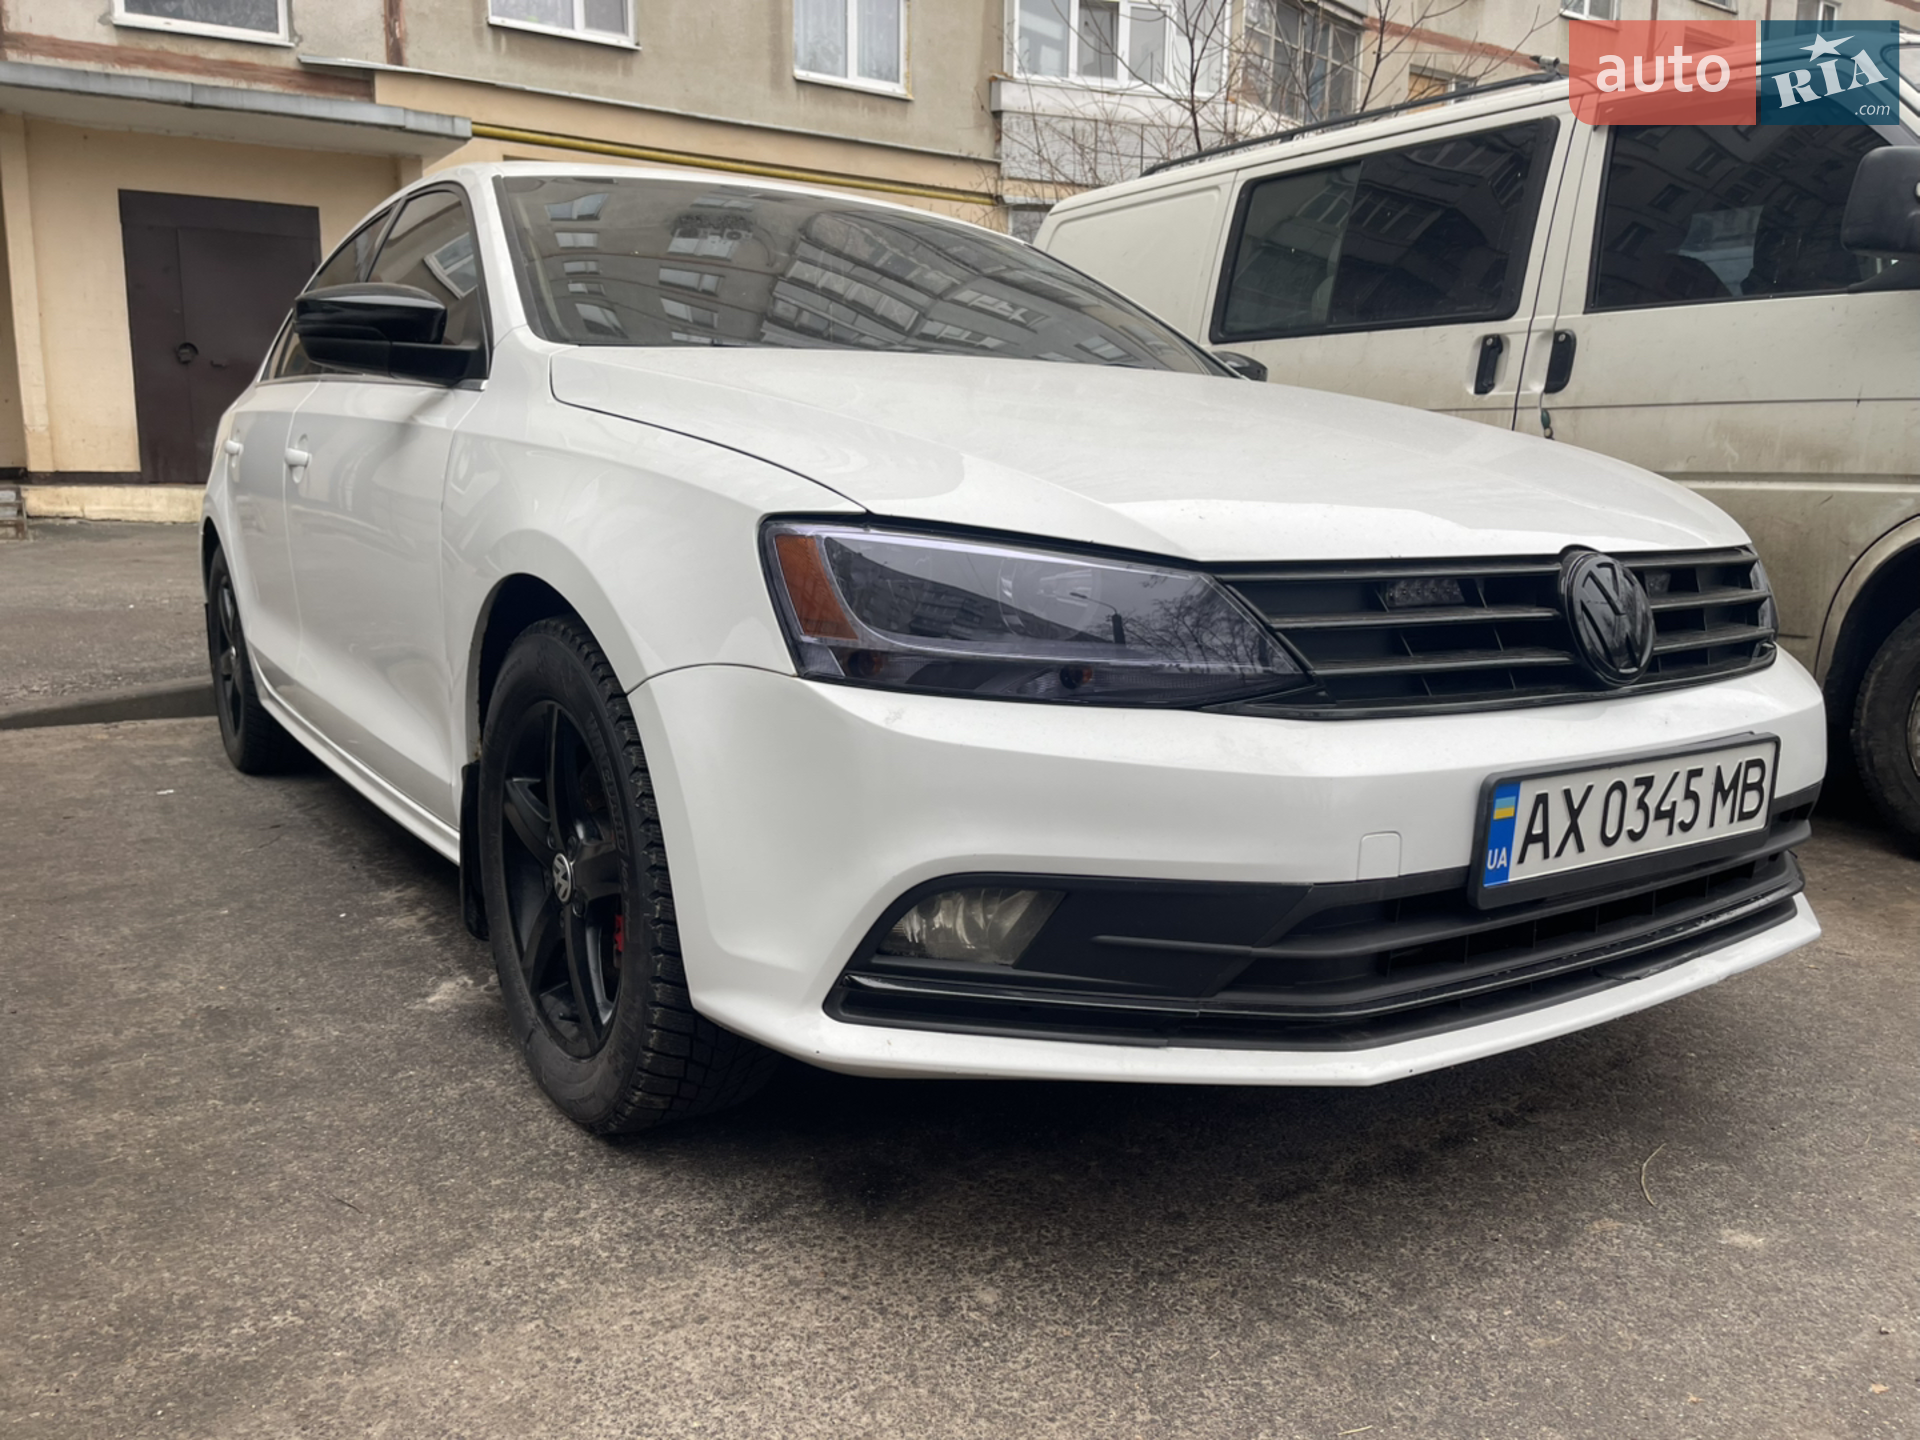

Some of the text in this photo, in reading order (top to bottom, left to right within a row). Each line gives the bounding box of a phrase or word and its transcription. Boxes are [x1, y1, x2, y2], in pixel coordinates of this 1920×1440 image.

[1517, 758, 1766, 865] AX 0345 MB
[1487, 846, 1507, 870] UA
